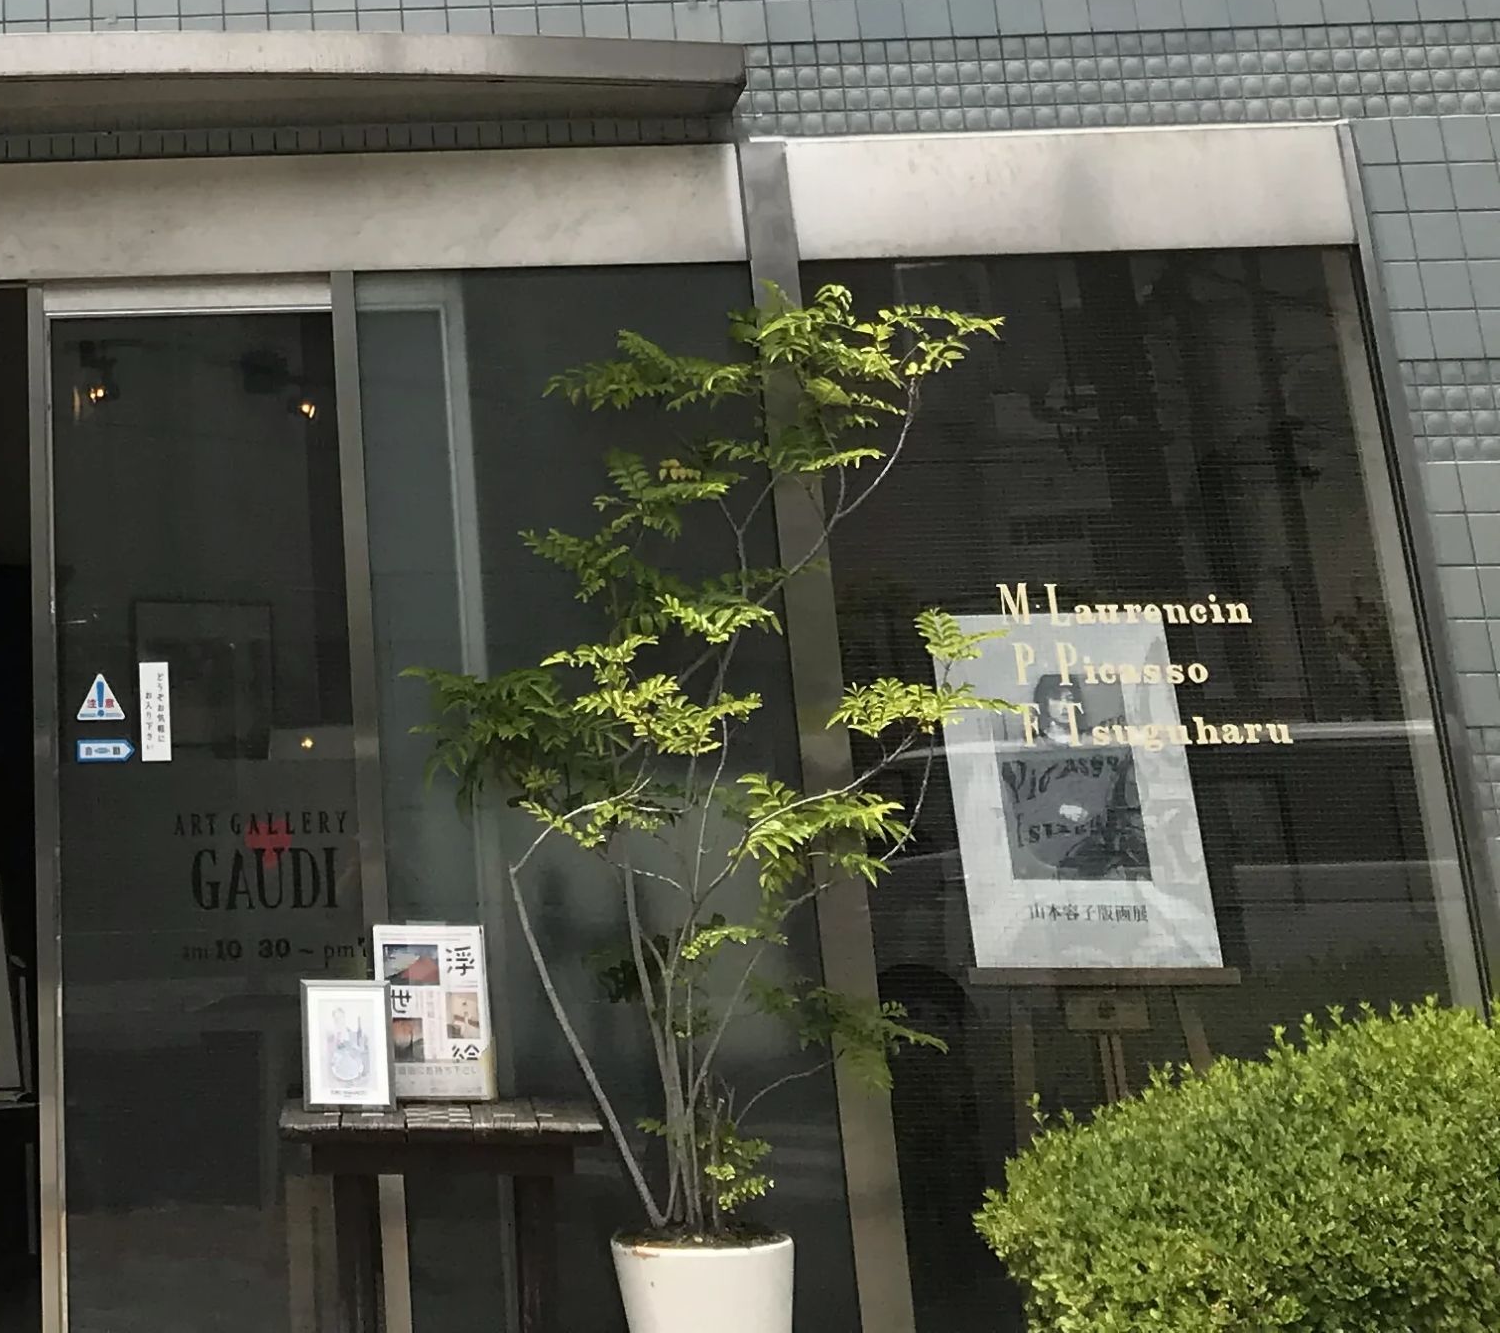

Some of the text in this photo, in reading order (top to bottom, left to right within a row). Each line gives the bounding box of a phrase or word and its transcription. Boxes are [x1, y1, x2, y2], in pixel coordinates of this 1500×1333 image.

[173, 810, 349, 836] ART GALLERY
[191, 847, 339, 911] GAUDI
